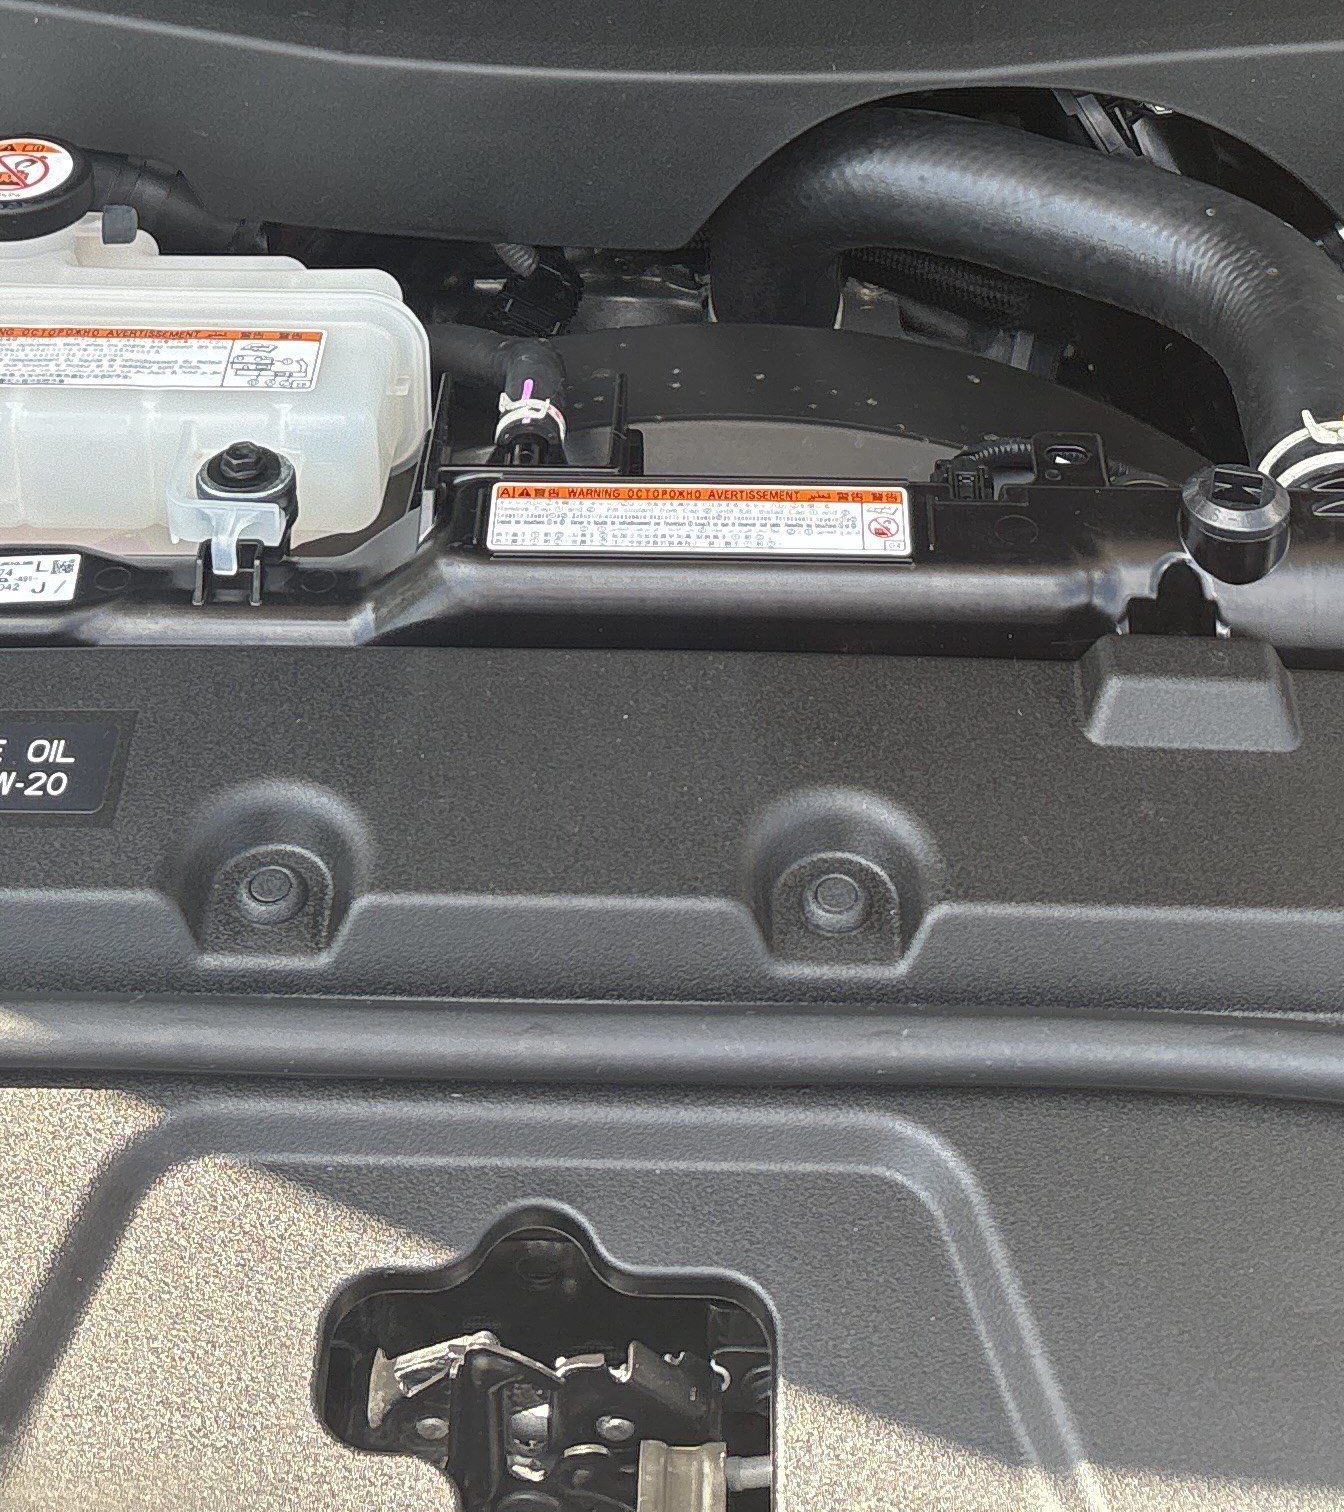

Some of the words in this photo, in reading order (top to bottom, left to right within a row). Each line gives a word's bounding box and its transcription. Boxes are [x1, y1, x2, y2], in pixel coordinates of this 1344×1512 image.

[106, 329, 200, 339] AVERTISSEMENT
[567, 488, 621, 499] WARNING
[708, 490, 800, 502] AVERTISSEMENT
[27, 739, 75, 764] OIL
